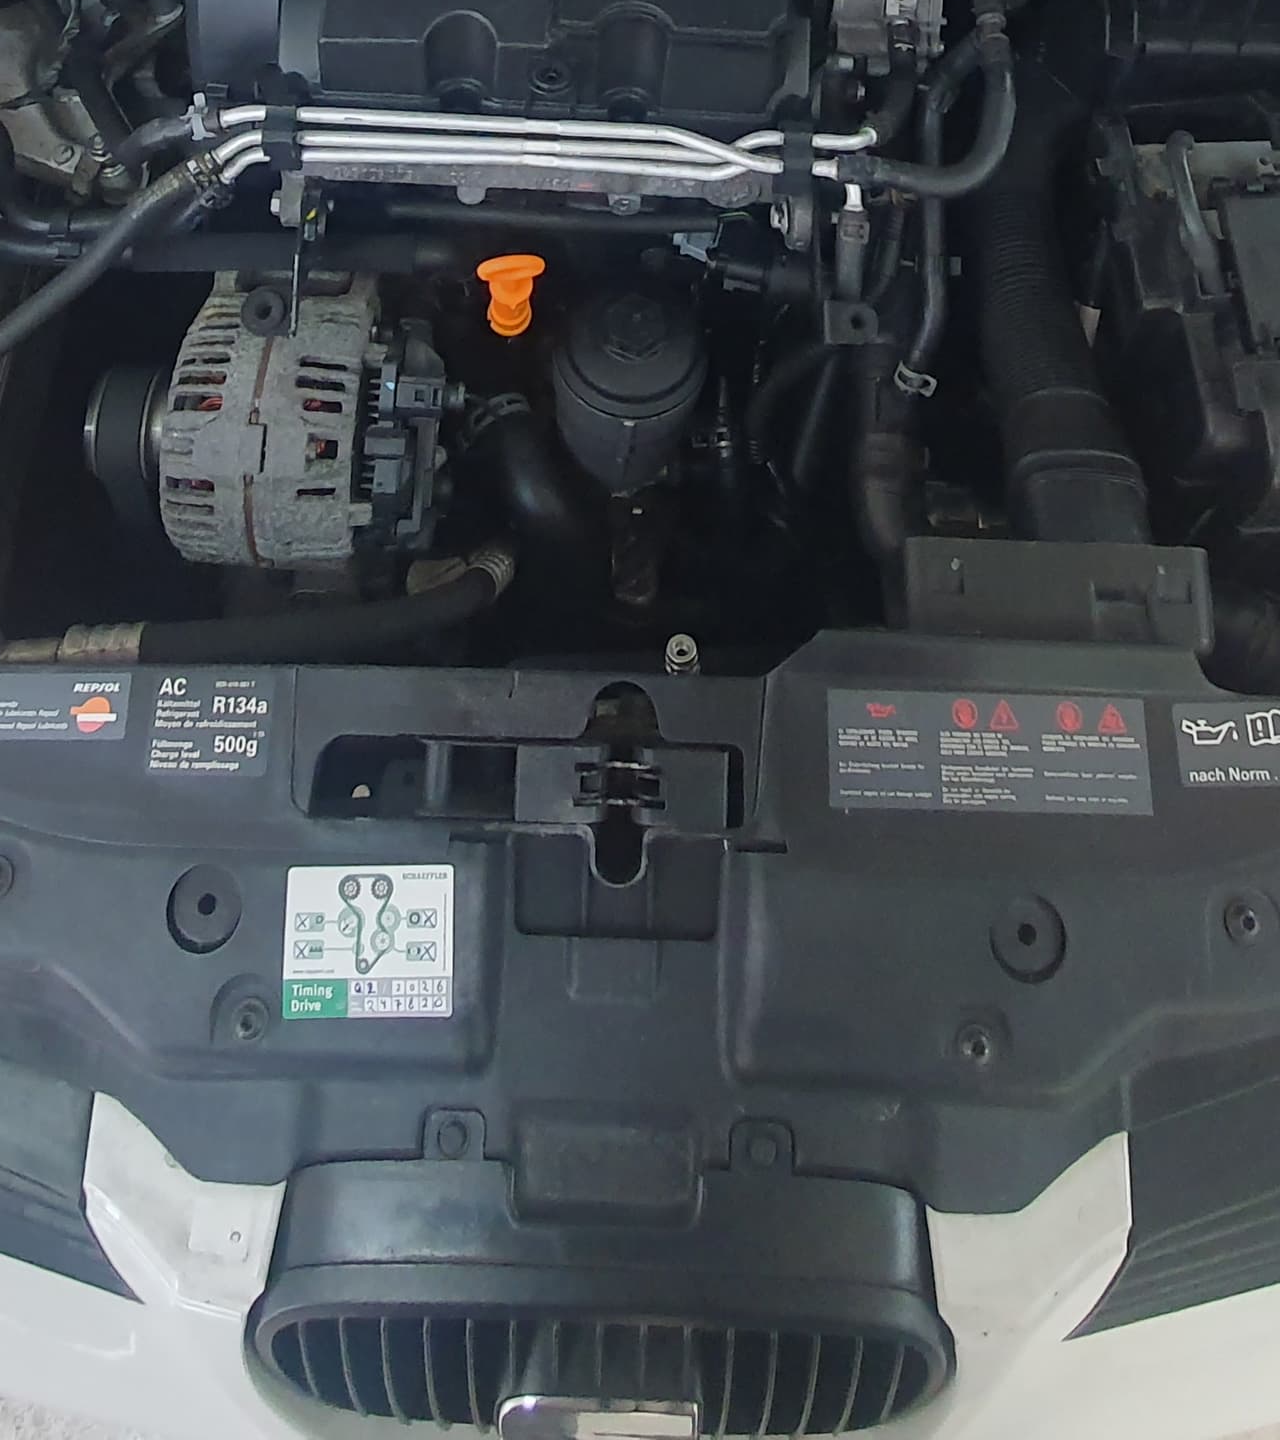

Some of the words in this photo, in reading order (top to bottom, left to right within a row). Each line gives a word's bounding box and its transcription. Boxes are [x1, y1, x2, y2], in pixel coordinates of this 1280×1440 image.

[73, 682, 120, 693] REPSOL
[159, 678, 187, 695] AC
[212, 695, 268, 714] R134a
[214, 735, 258, 758] 500g
[1189, 768, 1226, 782] nach
[1228, 767, 1271, 781] Norm
[291, 984, 333, 998] Timing
[290, 999, 322, 1012] Drive
